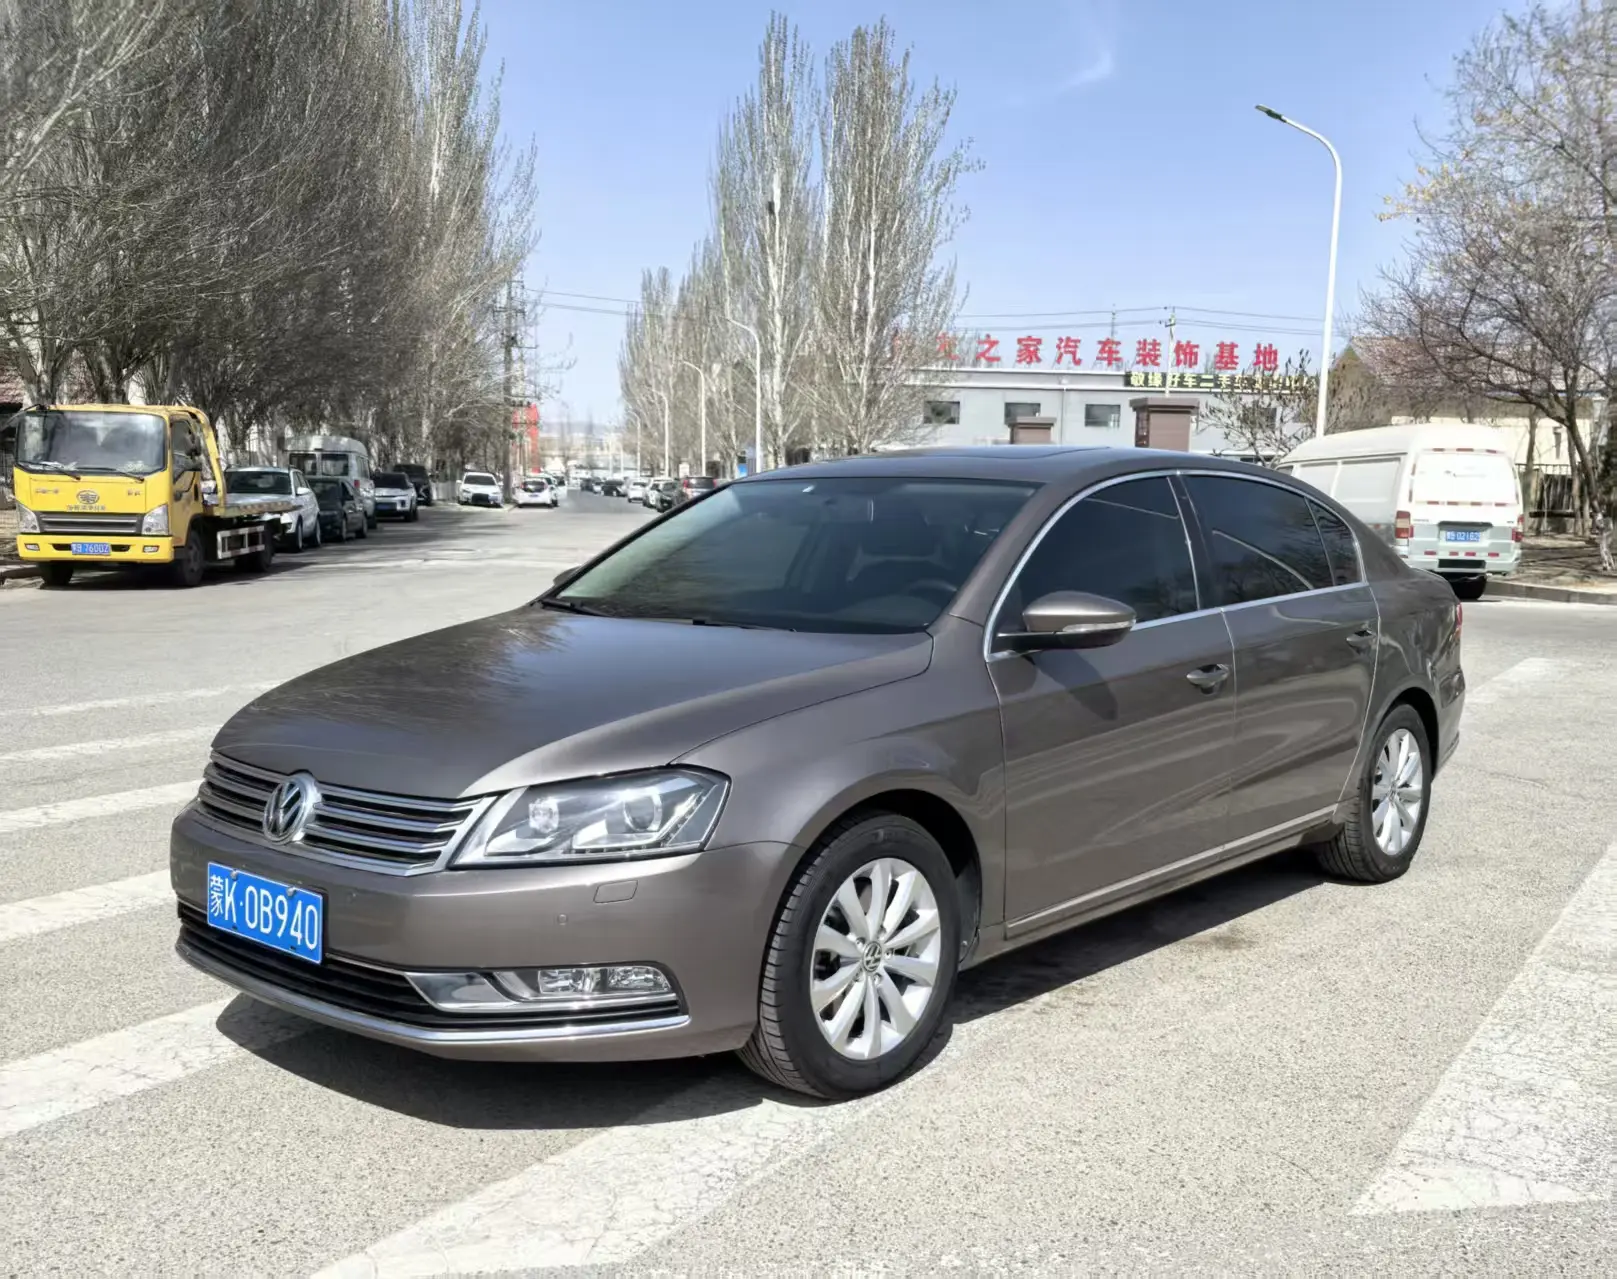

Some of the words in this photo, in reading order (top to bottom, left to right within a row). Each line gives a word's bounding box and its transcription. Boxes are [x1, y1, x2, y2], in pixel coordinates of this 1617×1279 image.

[891, 331, 1279, 371] 之家汽车装饰基地
